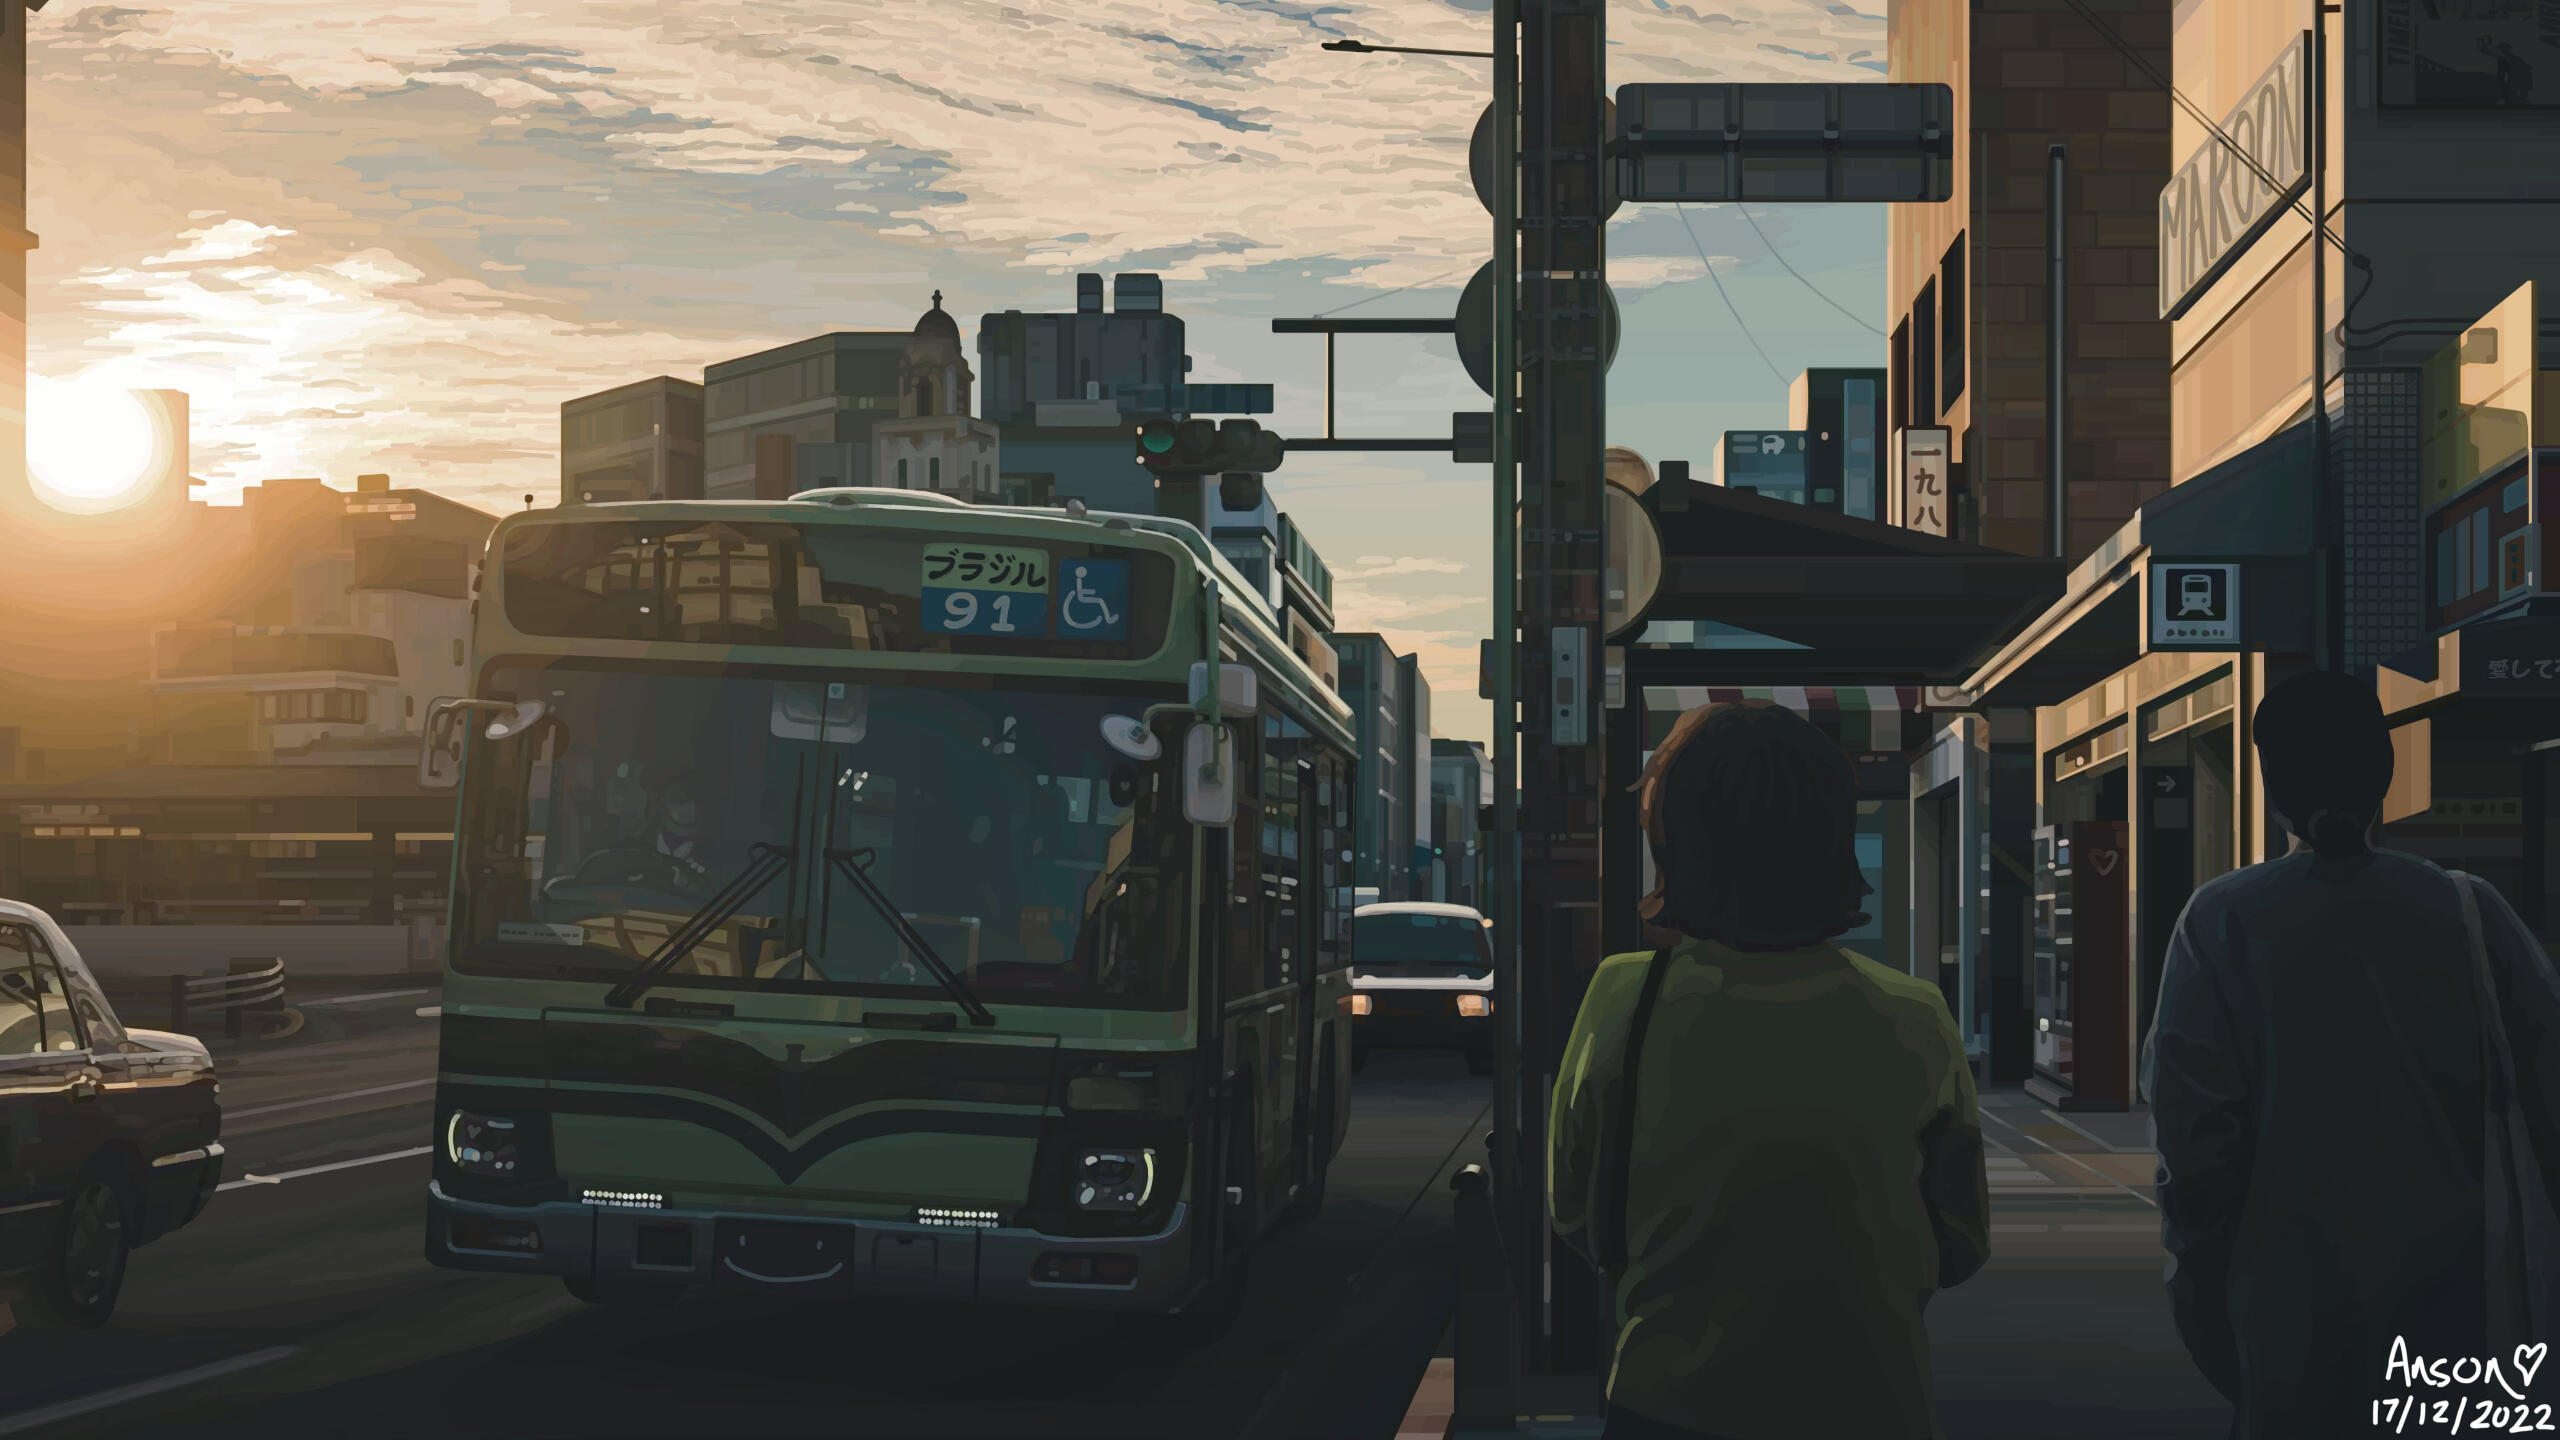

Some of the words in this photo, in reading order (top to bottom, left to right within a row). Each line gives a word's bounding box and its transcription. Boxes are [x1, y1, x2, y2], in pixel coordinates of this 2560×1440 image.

[2161, 46, 2300, 311] MAROON
[1910, 449, 1942, 528] 一九八
[924, 548, 1047, 587] ブラジル
[943, 592, 1015, 632] 91
